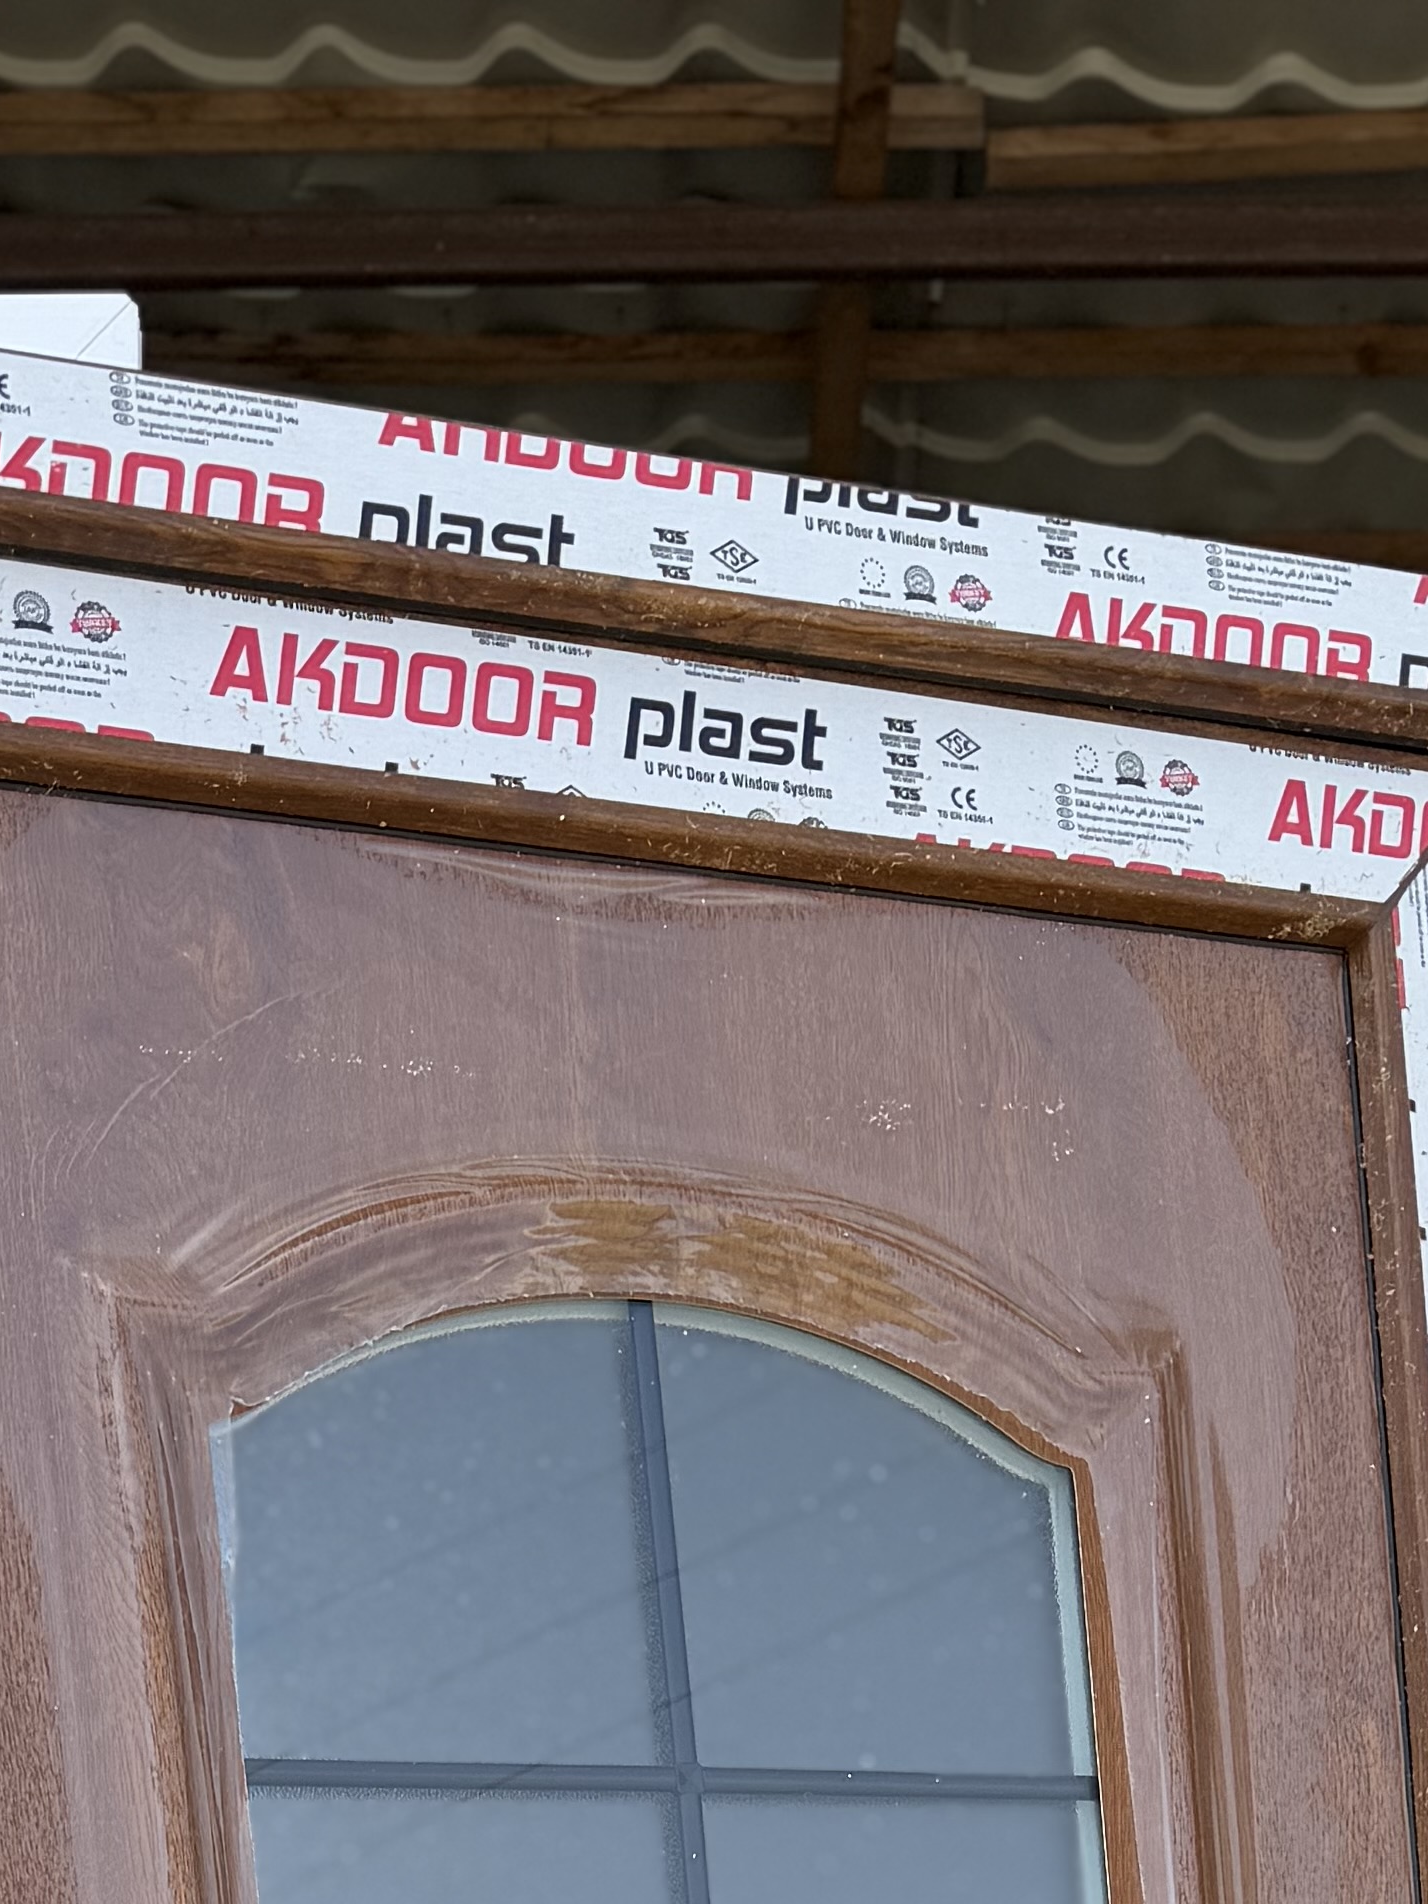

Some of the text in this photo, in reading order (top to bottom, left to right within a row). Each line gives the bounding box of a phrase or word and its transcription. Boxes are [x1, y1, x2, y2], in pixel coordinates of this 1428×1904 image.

[210, 626, 596, 747] AKDOOR
[624, 690, 827, 771] plast
[644, 760, 832, 799] U PVC Door & Window Systems
